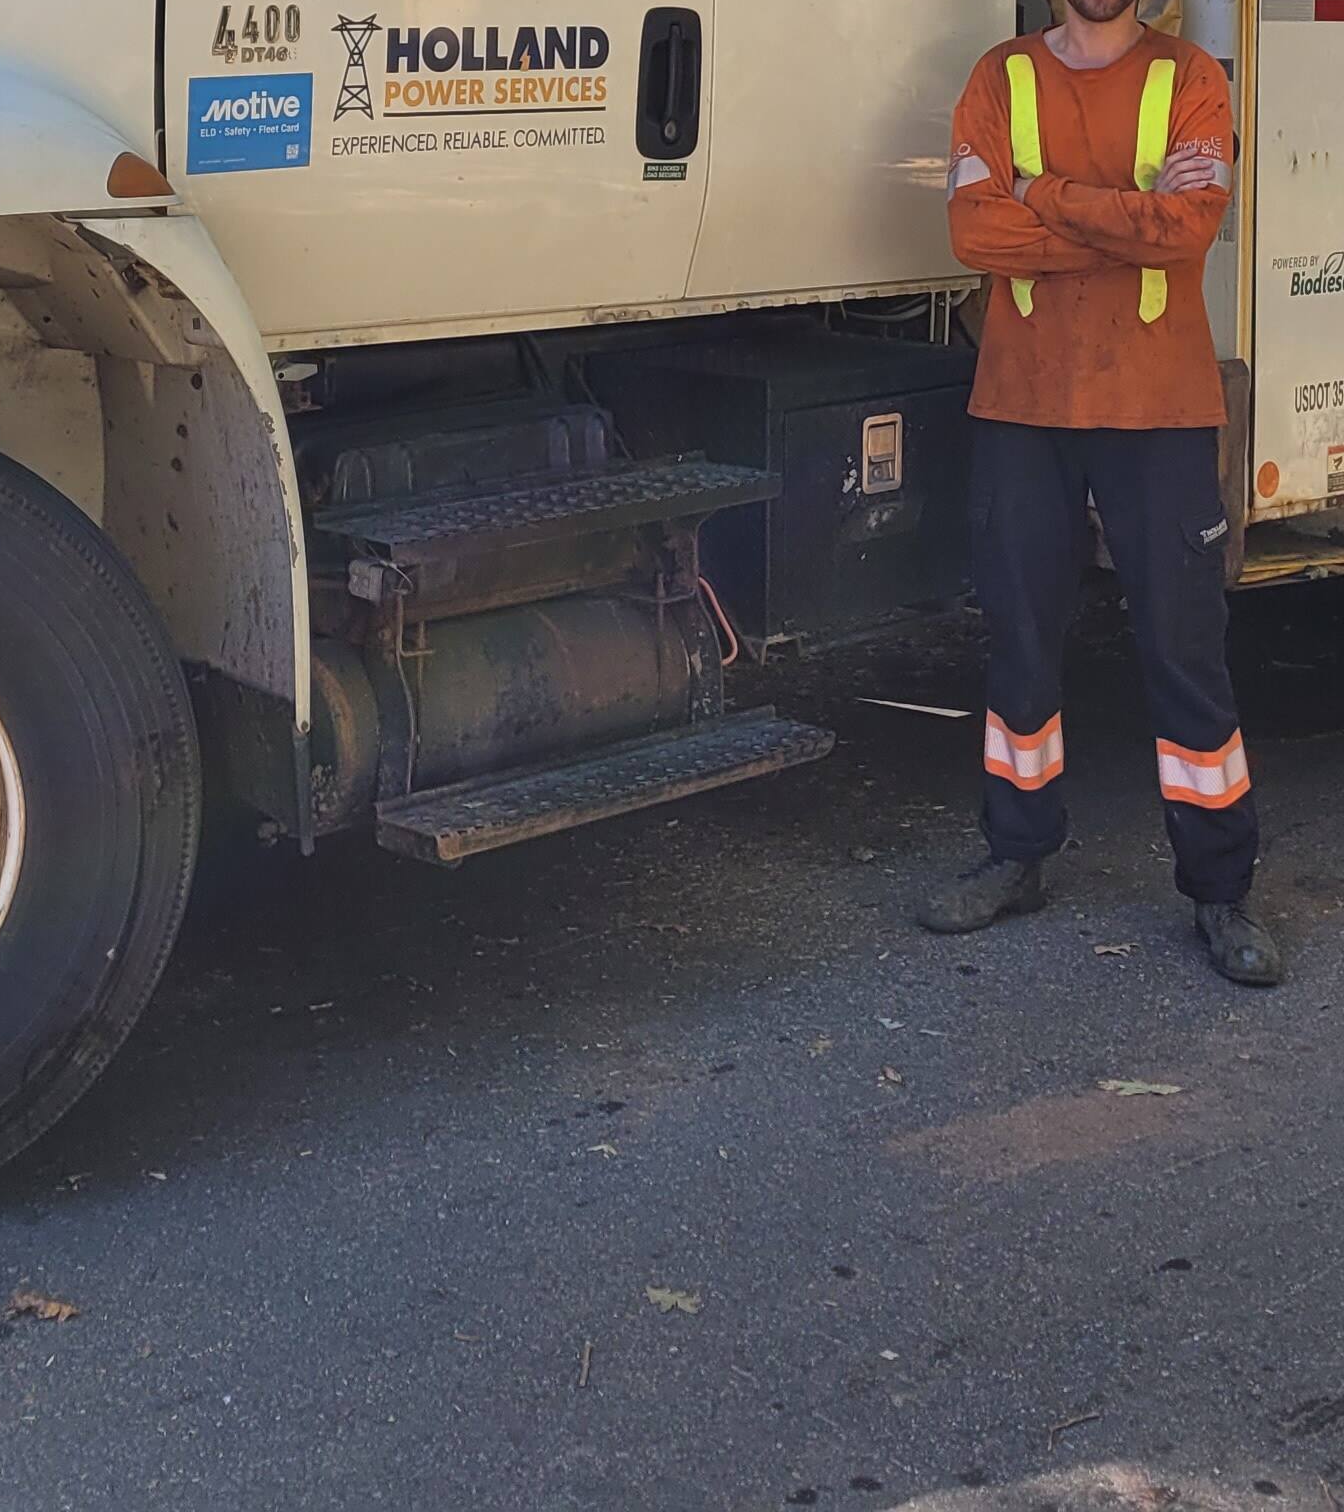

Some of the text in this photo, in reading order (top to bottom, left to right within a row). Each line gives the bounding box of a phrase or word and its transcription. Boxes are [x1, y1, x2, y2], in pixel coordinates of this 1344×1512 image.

[211, 4, 301, 64] 4400
[385, 26, 610, 74] HOLLAND
[200, 90, 301, 123] Motive
[384, 76, 607, 108] POWER SERVICES
[200, 122, 300, 138] ELD Safety Fleet Card
[331, 127, 606, 156] EXPERIENCED. RELIABLE. COMMITTED.
[1272, 255, 1320, 270] POWERED BY
[1294, 381, 1331, 414] USDOT
